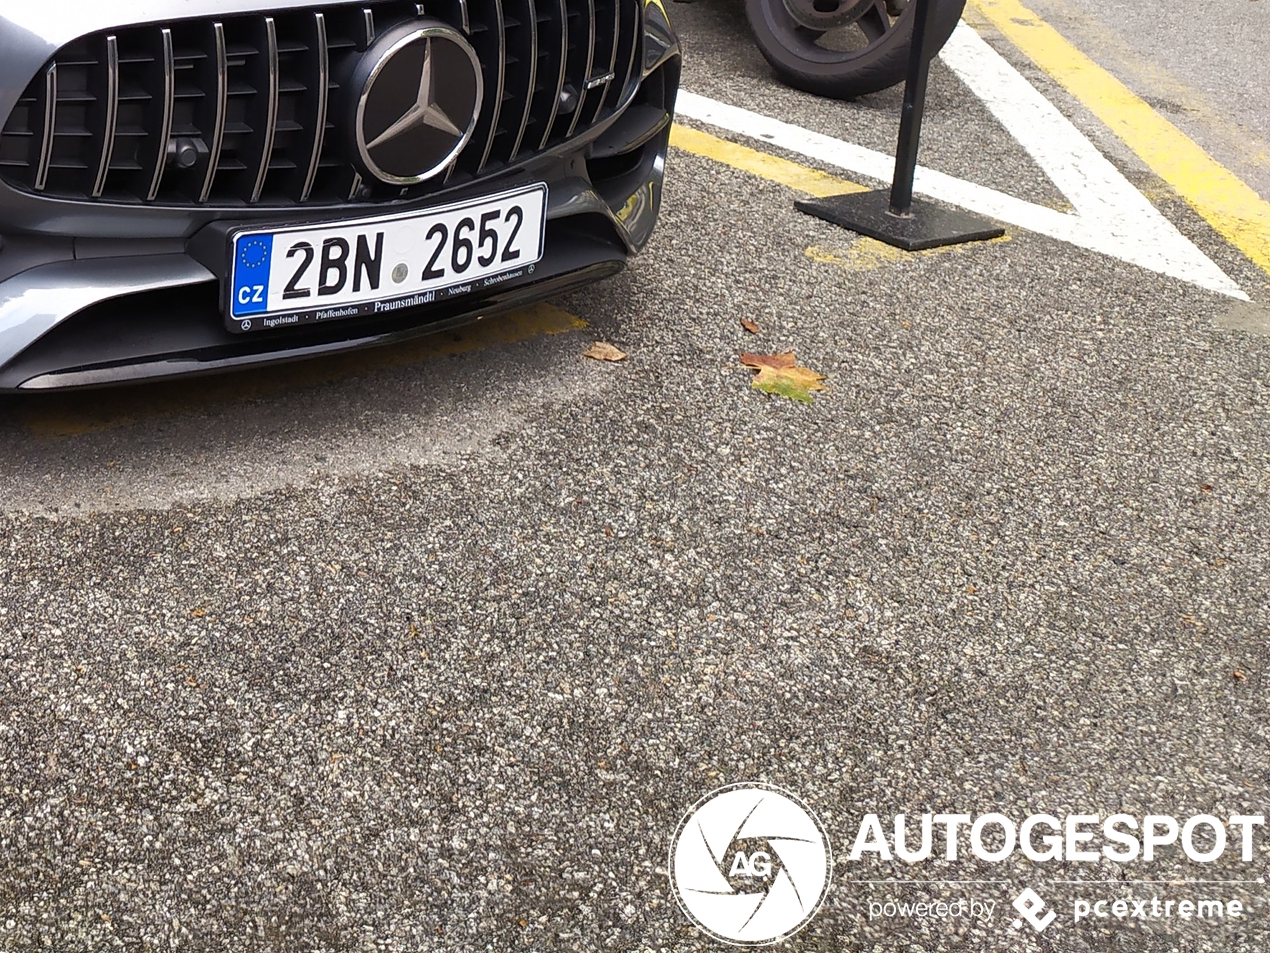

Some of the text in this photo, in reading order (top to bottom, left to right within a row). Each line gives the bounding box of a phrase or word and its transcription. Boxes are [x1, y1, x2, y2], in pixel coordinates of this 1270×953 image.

[282, 204, 524, 300] 2BN 2652
[238, 284, 264, 305] CZ
[263, 313, 299, 328] Ingolstadt
[315, 306, 359, 320] Pfaffenhofen
[373, 290, 436, 313] Praunsmändtl
[447, 284, 473, 297] Neuburg
